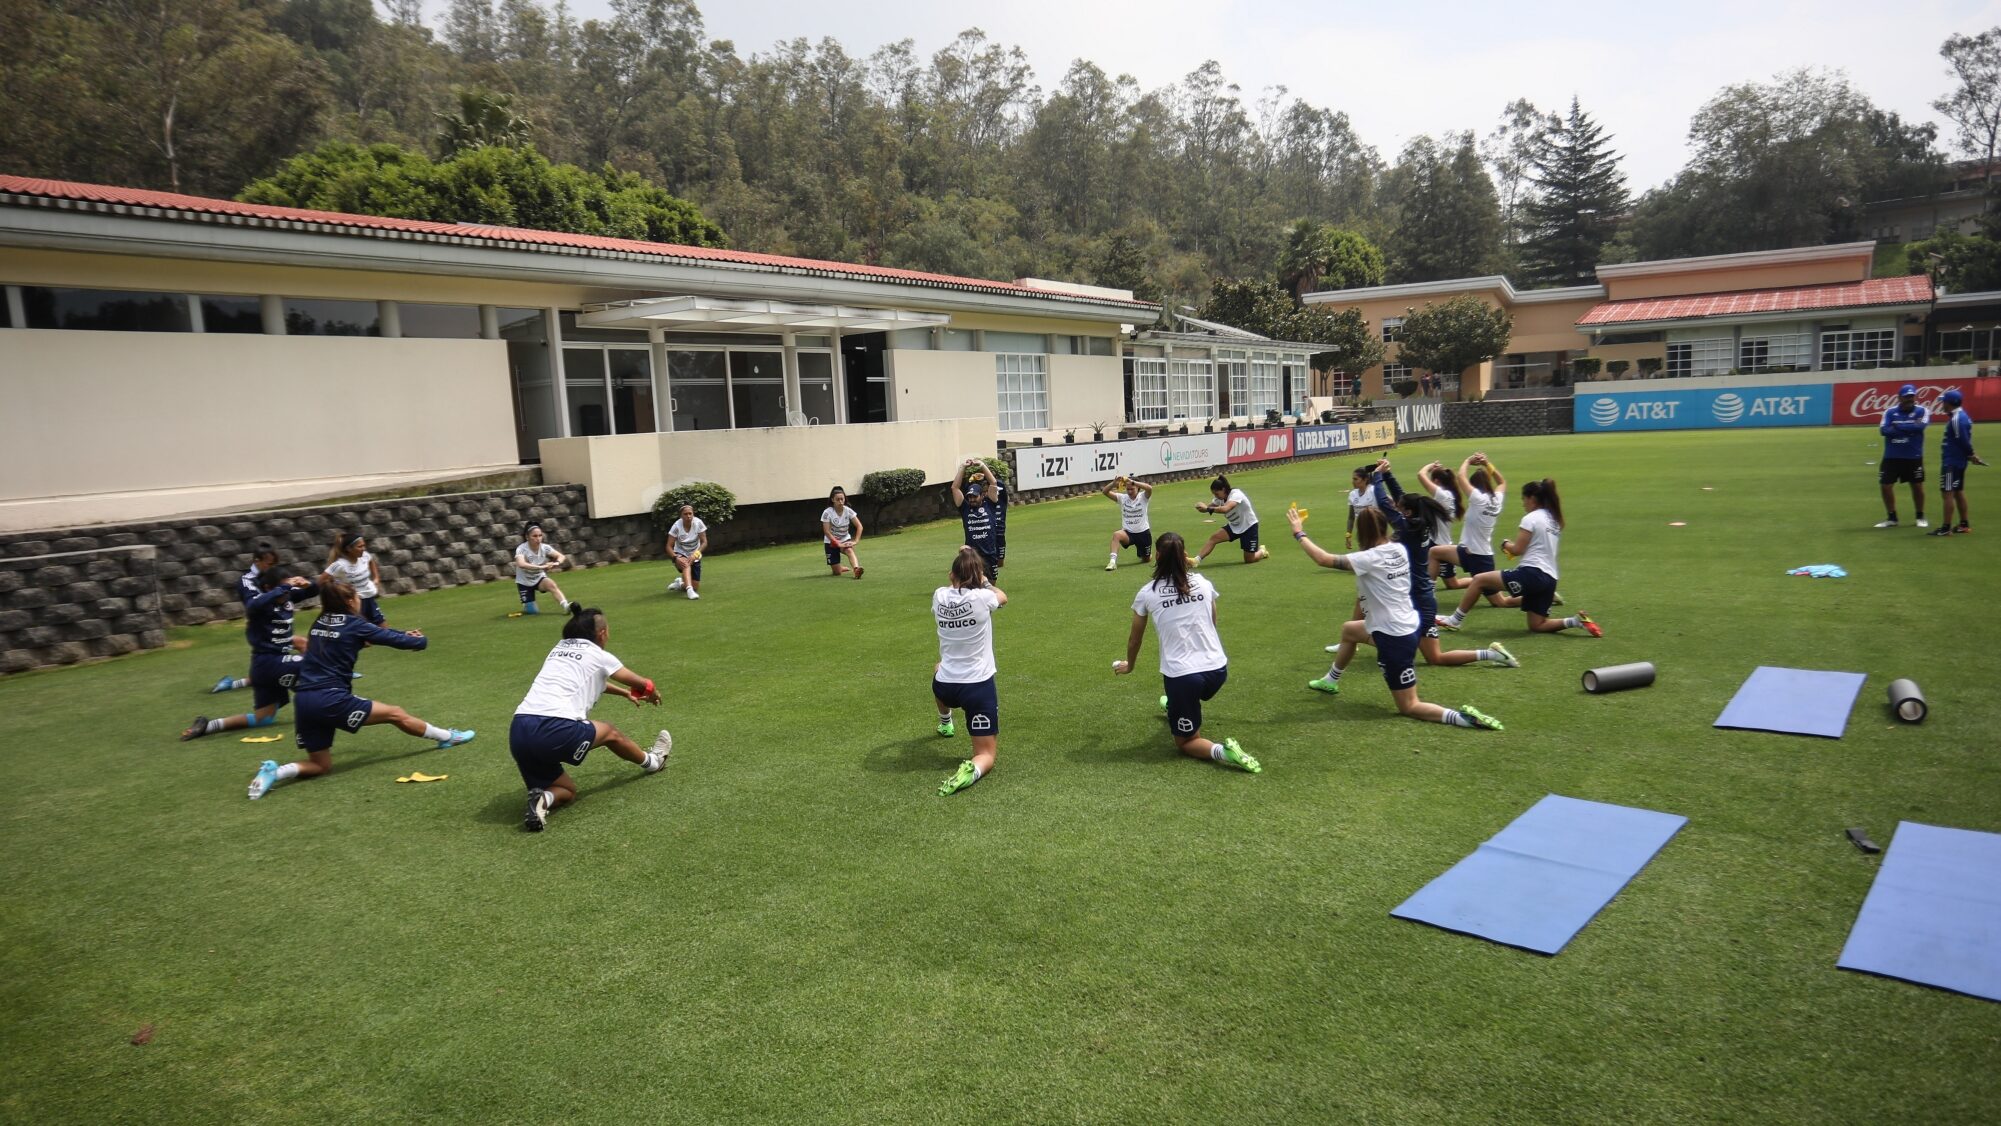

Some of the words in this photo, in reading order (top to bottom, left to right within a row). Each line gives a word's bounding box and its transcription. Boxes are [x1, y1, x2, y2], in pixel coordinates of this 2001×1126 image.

[1625, 400, 1679, 420] AT&T
[1750, 396, 1811, 416] AT&T
[1412, 403, 1442, 432] KAVAK
[1228, 436, 1256, 458] ADO
[1264, 434, 1288, 454] ADO
[1162, 594, 1204, 608] arauco
[939, 606, 970, 618] CRISTAL
[938, 618, 977, 629] arauco
[549, 650, 583, 661] arauco
